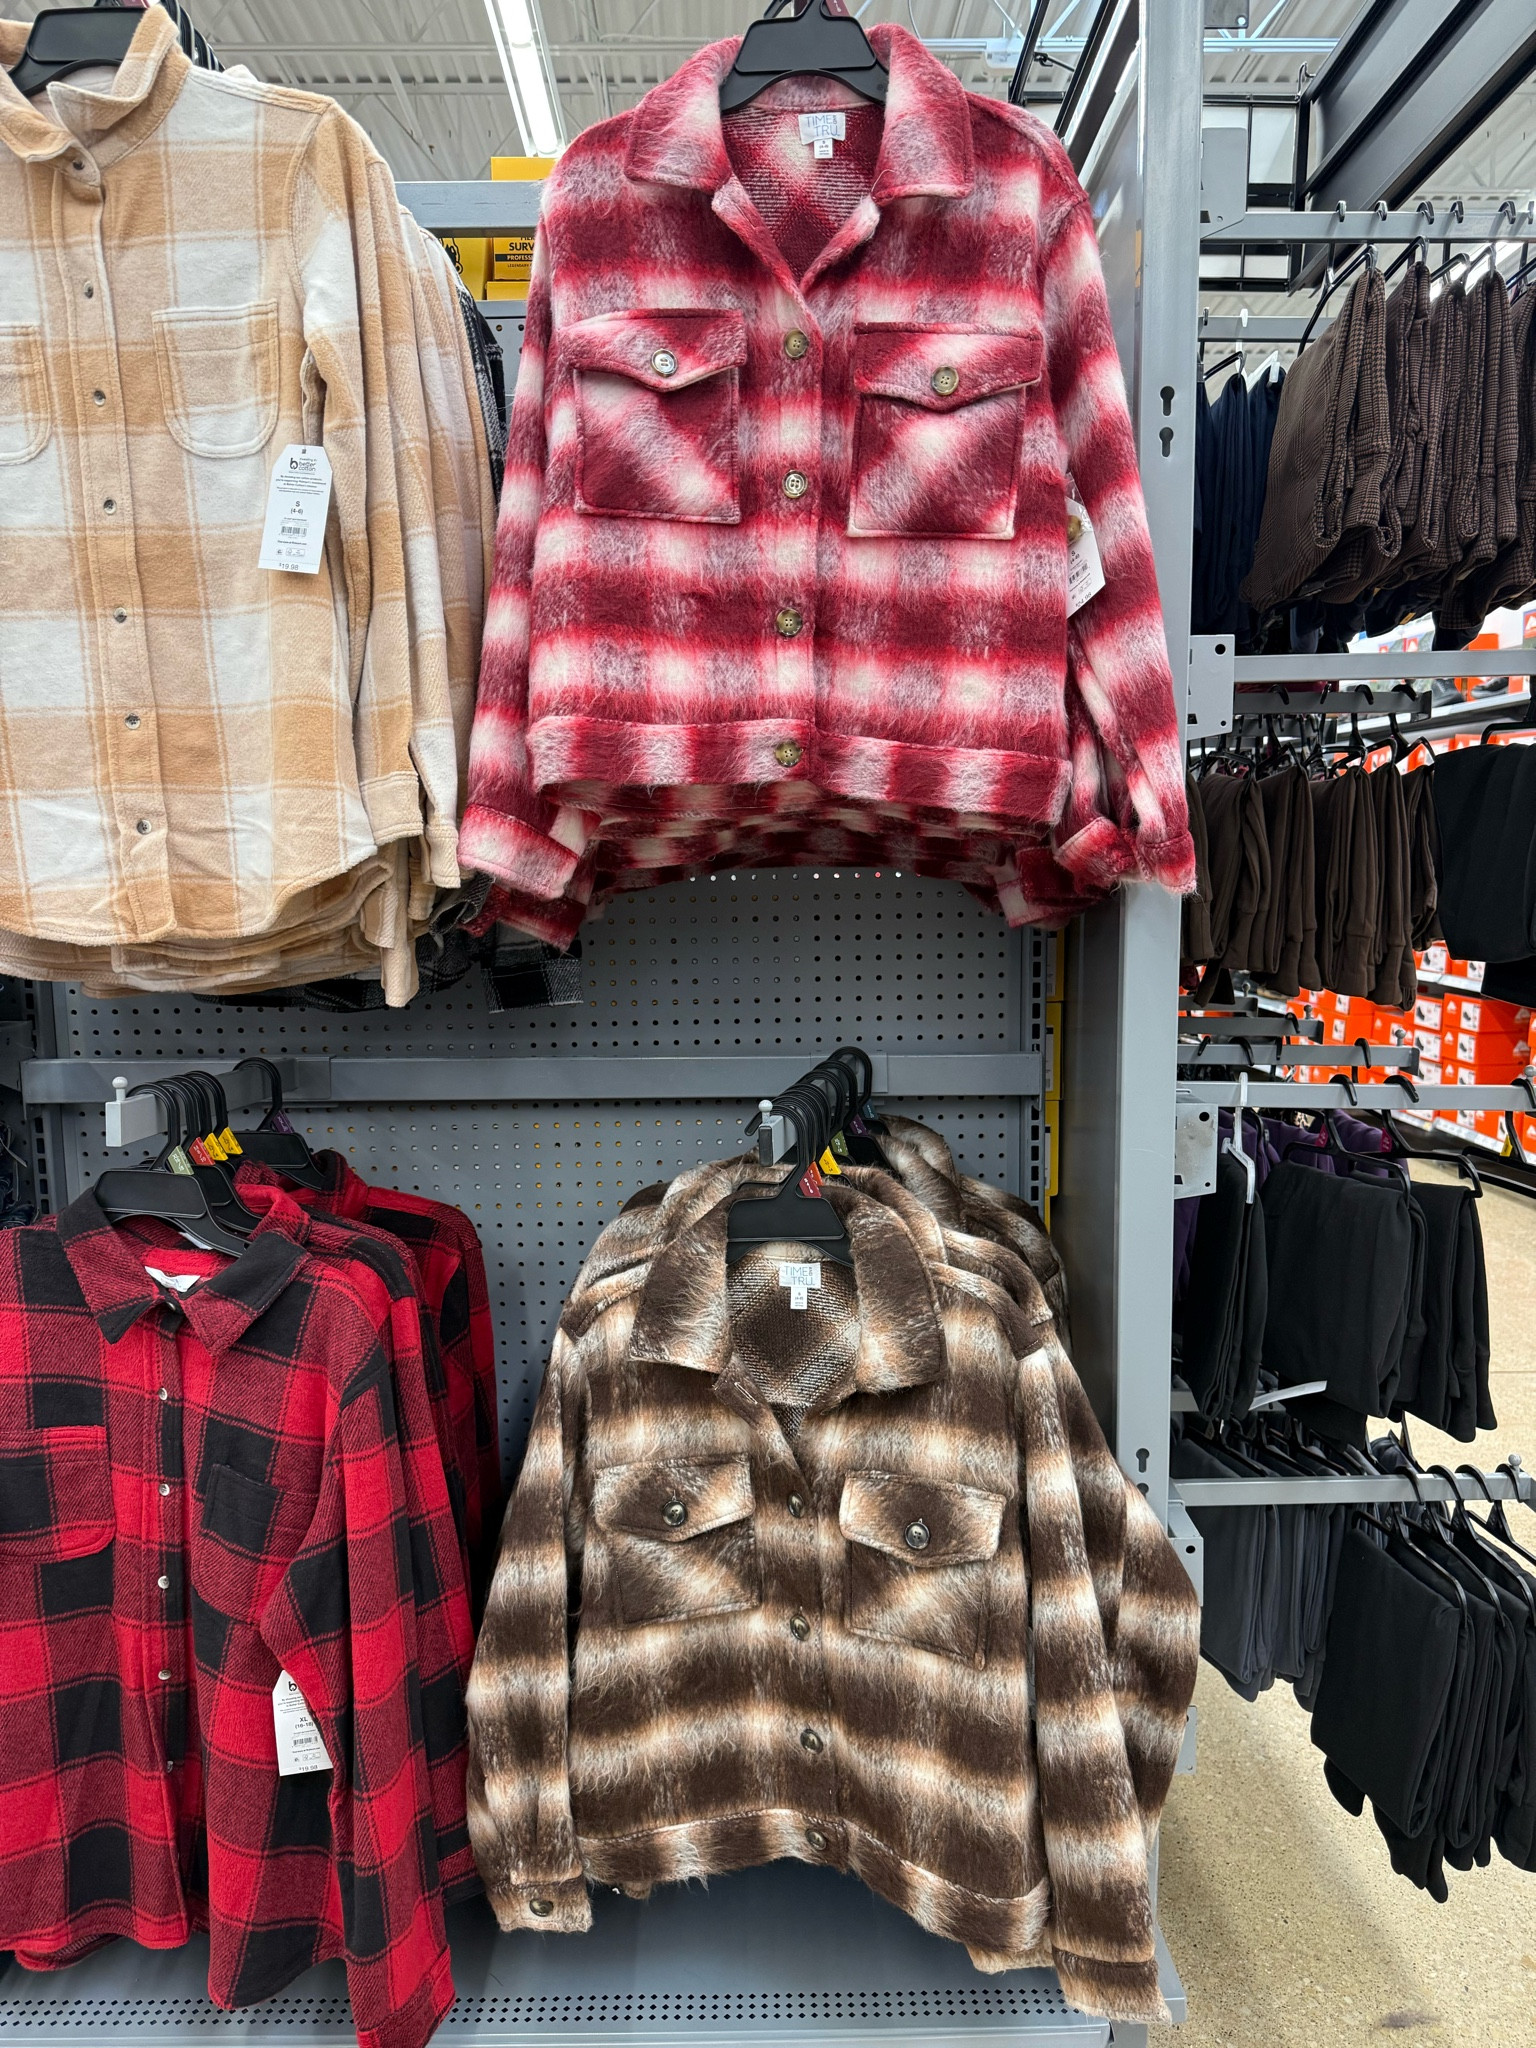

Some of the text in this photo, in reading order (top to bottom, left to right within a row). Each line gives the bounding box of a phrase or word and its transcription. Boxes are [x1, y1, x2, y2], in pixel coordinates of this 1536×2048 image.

[806, 114, 833, 128] TIME
[814, 124, 838, 137] TRU
[295, 500, 301, 508] S
[784, 1265, 808, 1276] TIME
[791, 1276, 814, 1286] TRU
